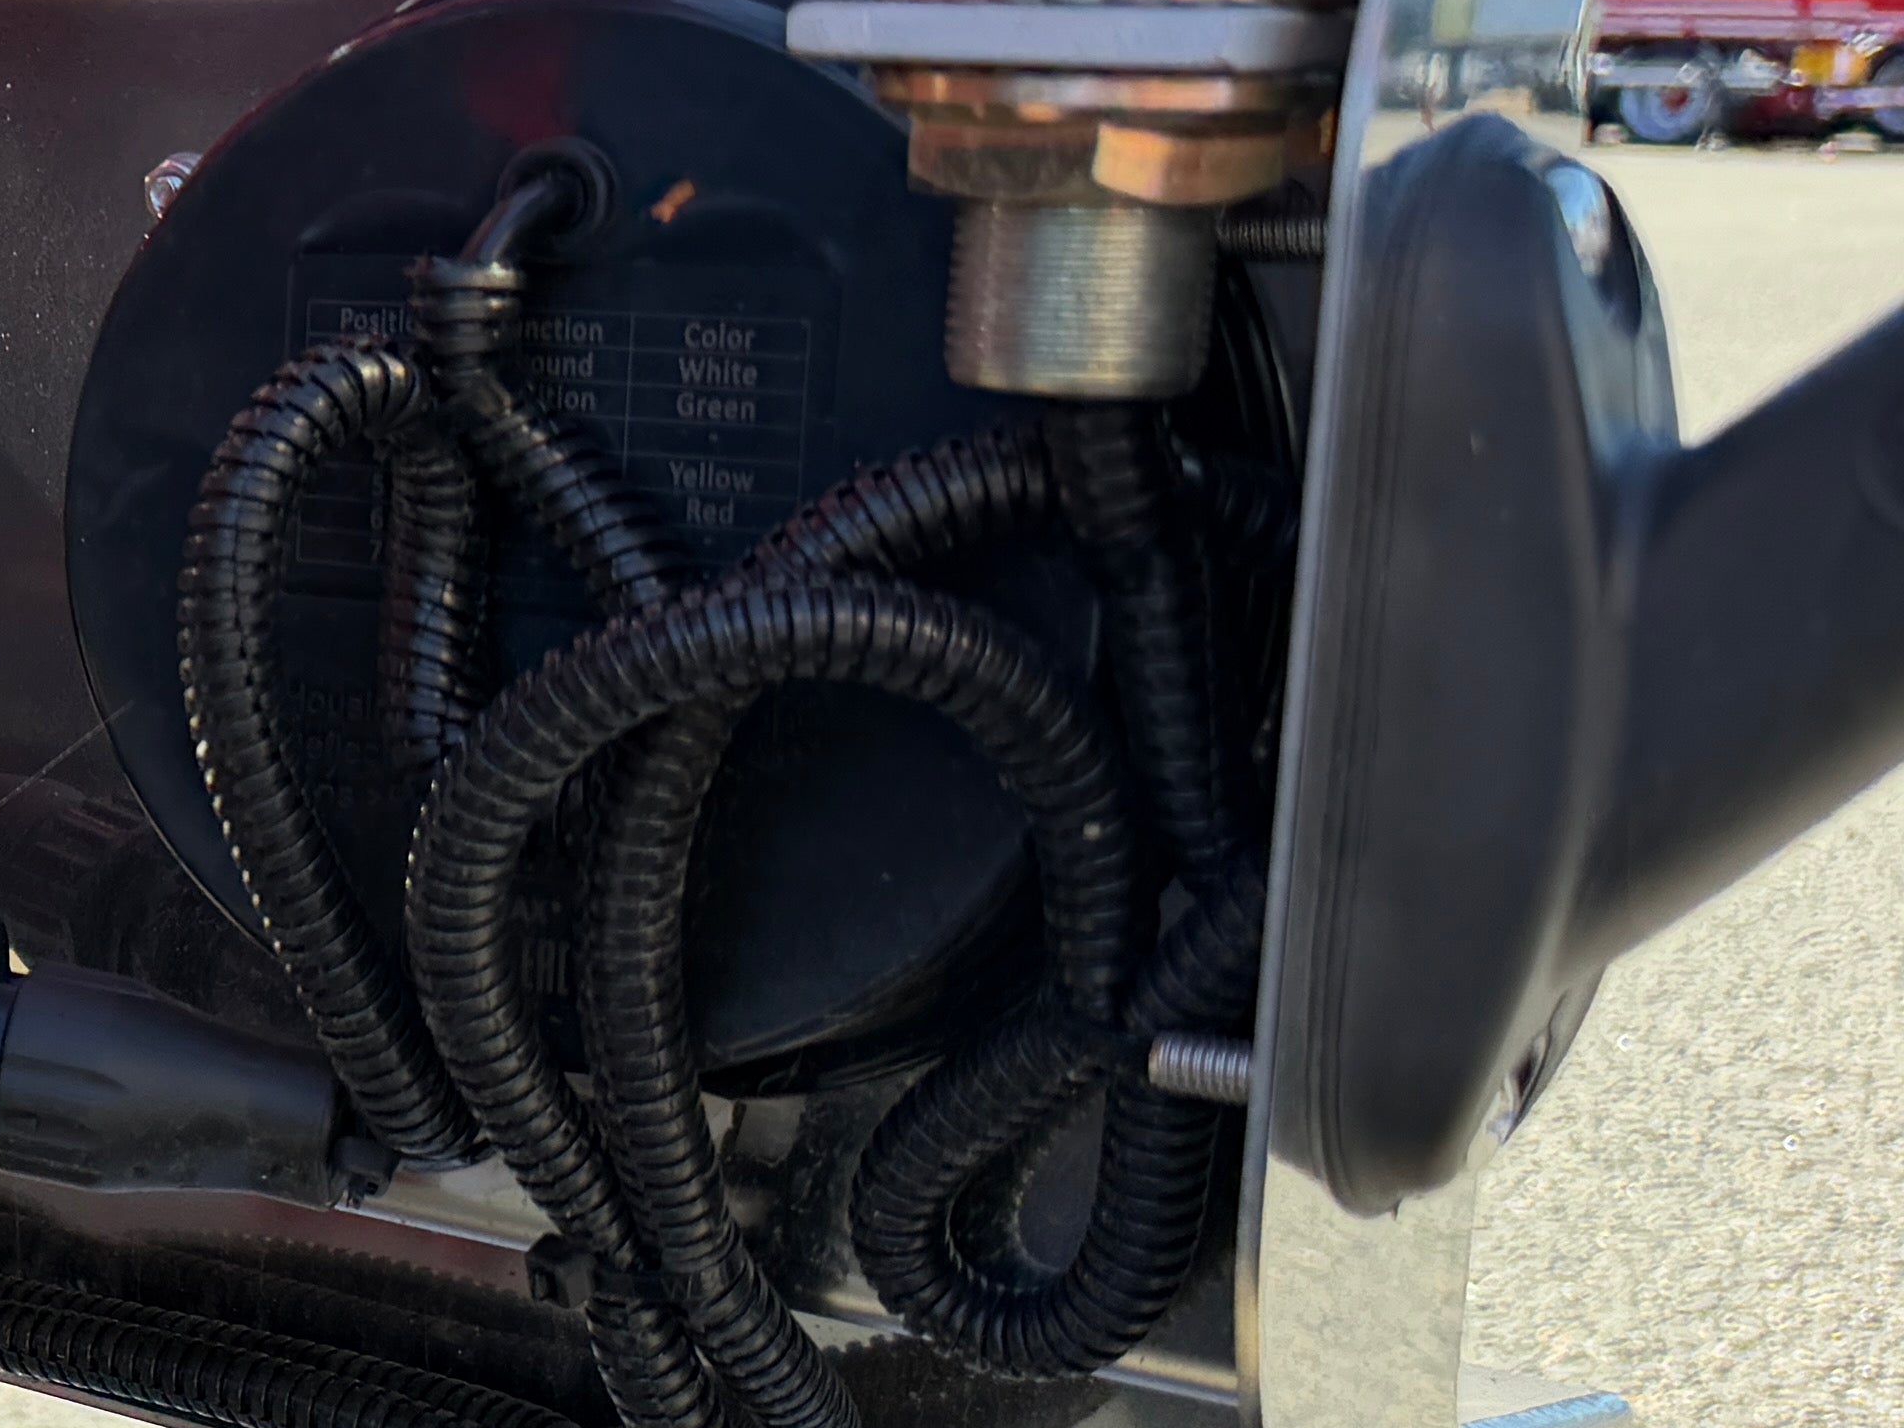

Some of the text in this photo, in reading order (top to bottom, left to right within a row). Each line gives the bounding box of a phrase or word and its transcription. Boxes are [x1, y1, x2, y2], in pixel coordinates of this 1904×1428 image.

[684, 322, 757, 351] Color
[677, 356, 759, 386] White
[675, 390, 756, 422] Green
[668, 460, 755, 492] Yellow
[685, 495, 735, 524] Red
